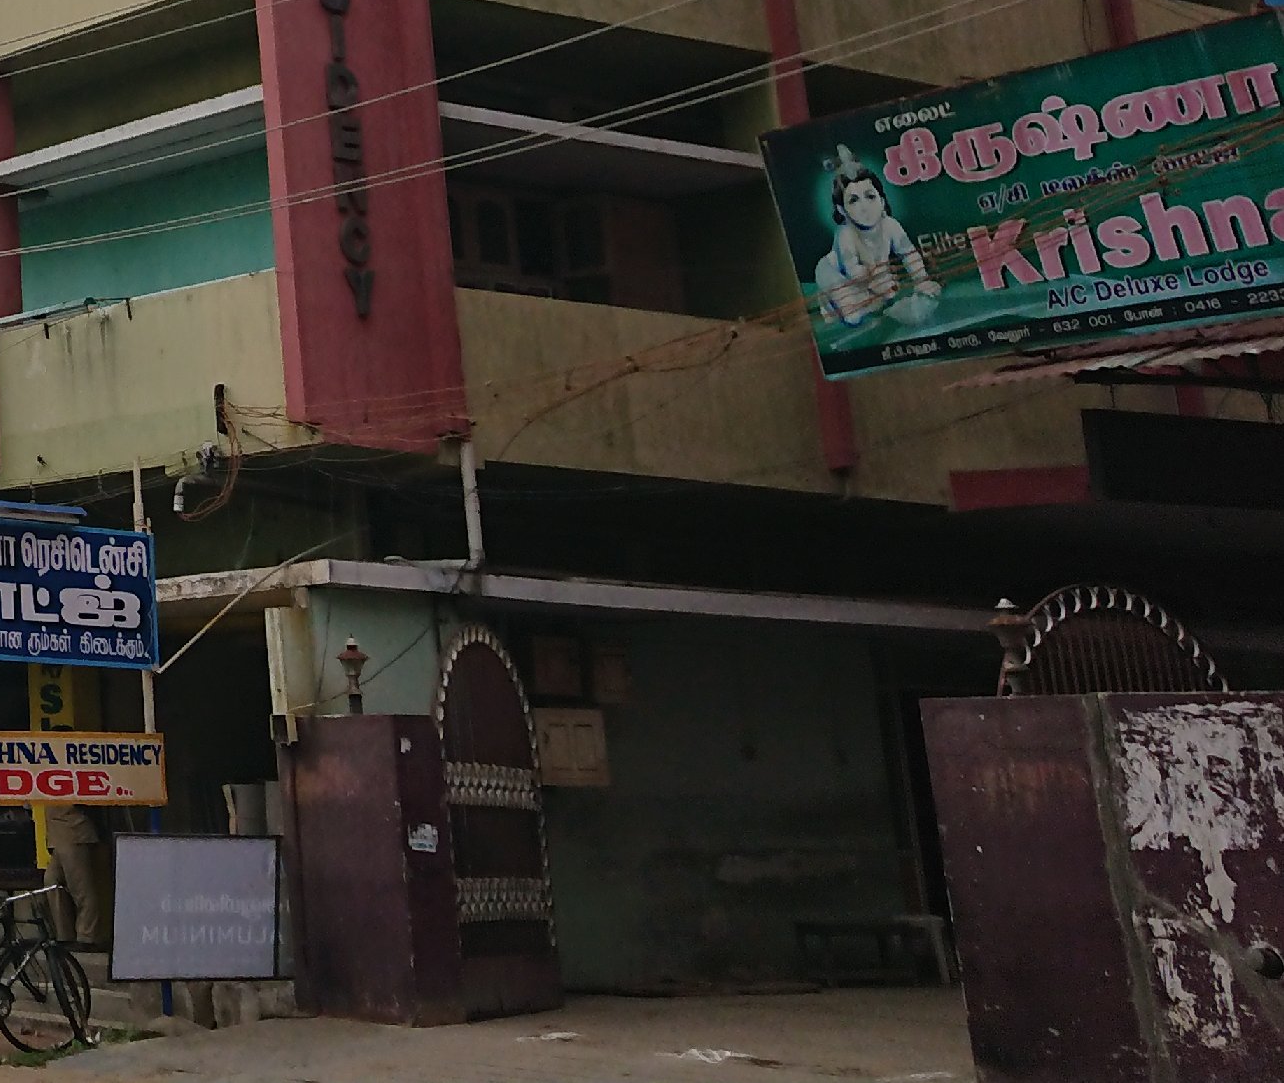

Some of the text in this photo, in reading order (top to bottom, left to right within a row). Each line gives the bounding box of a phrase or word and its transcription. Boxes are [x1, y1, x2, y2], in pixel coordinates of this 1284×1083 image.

[882, 61, 1282, 187] கிருஷ்ணா
[916, 230, 968, 258] Elite
[1046, 258, 1270, 310] A/C Deluxe Lodge
[1052, 317, 1080, 333] 632
[1184, 298, 1222, 314] 0416
[20, 531, 149, 579] ரெசிடென்சி
[65, 742, 163, 766] RESIDENCY
